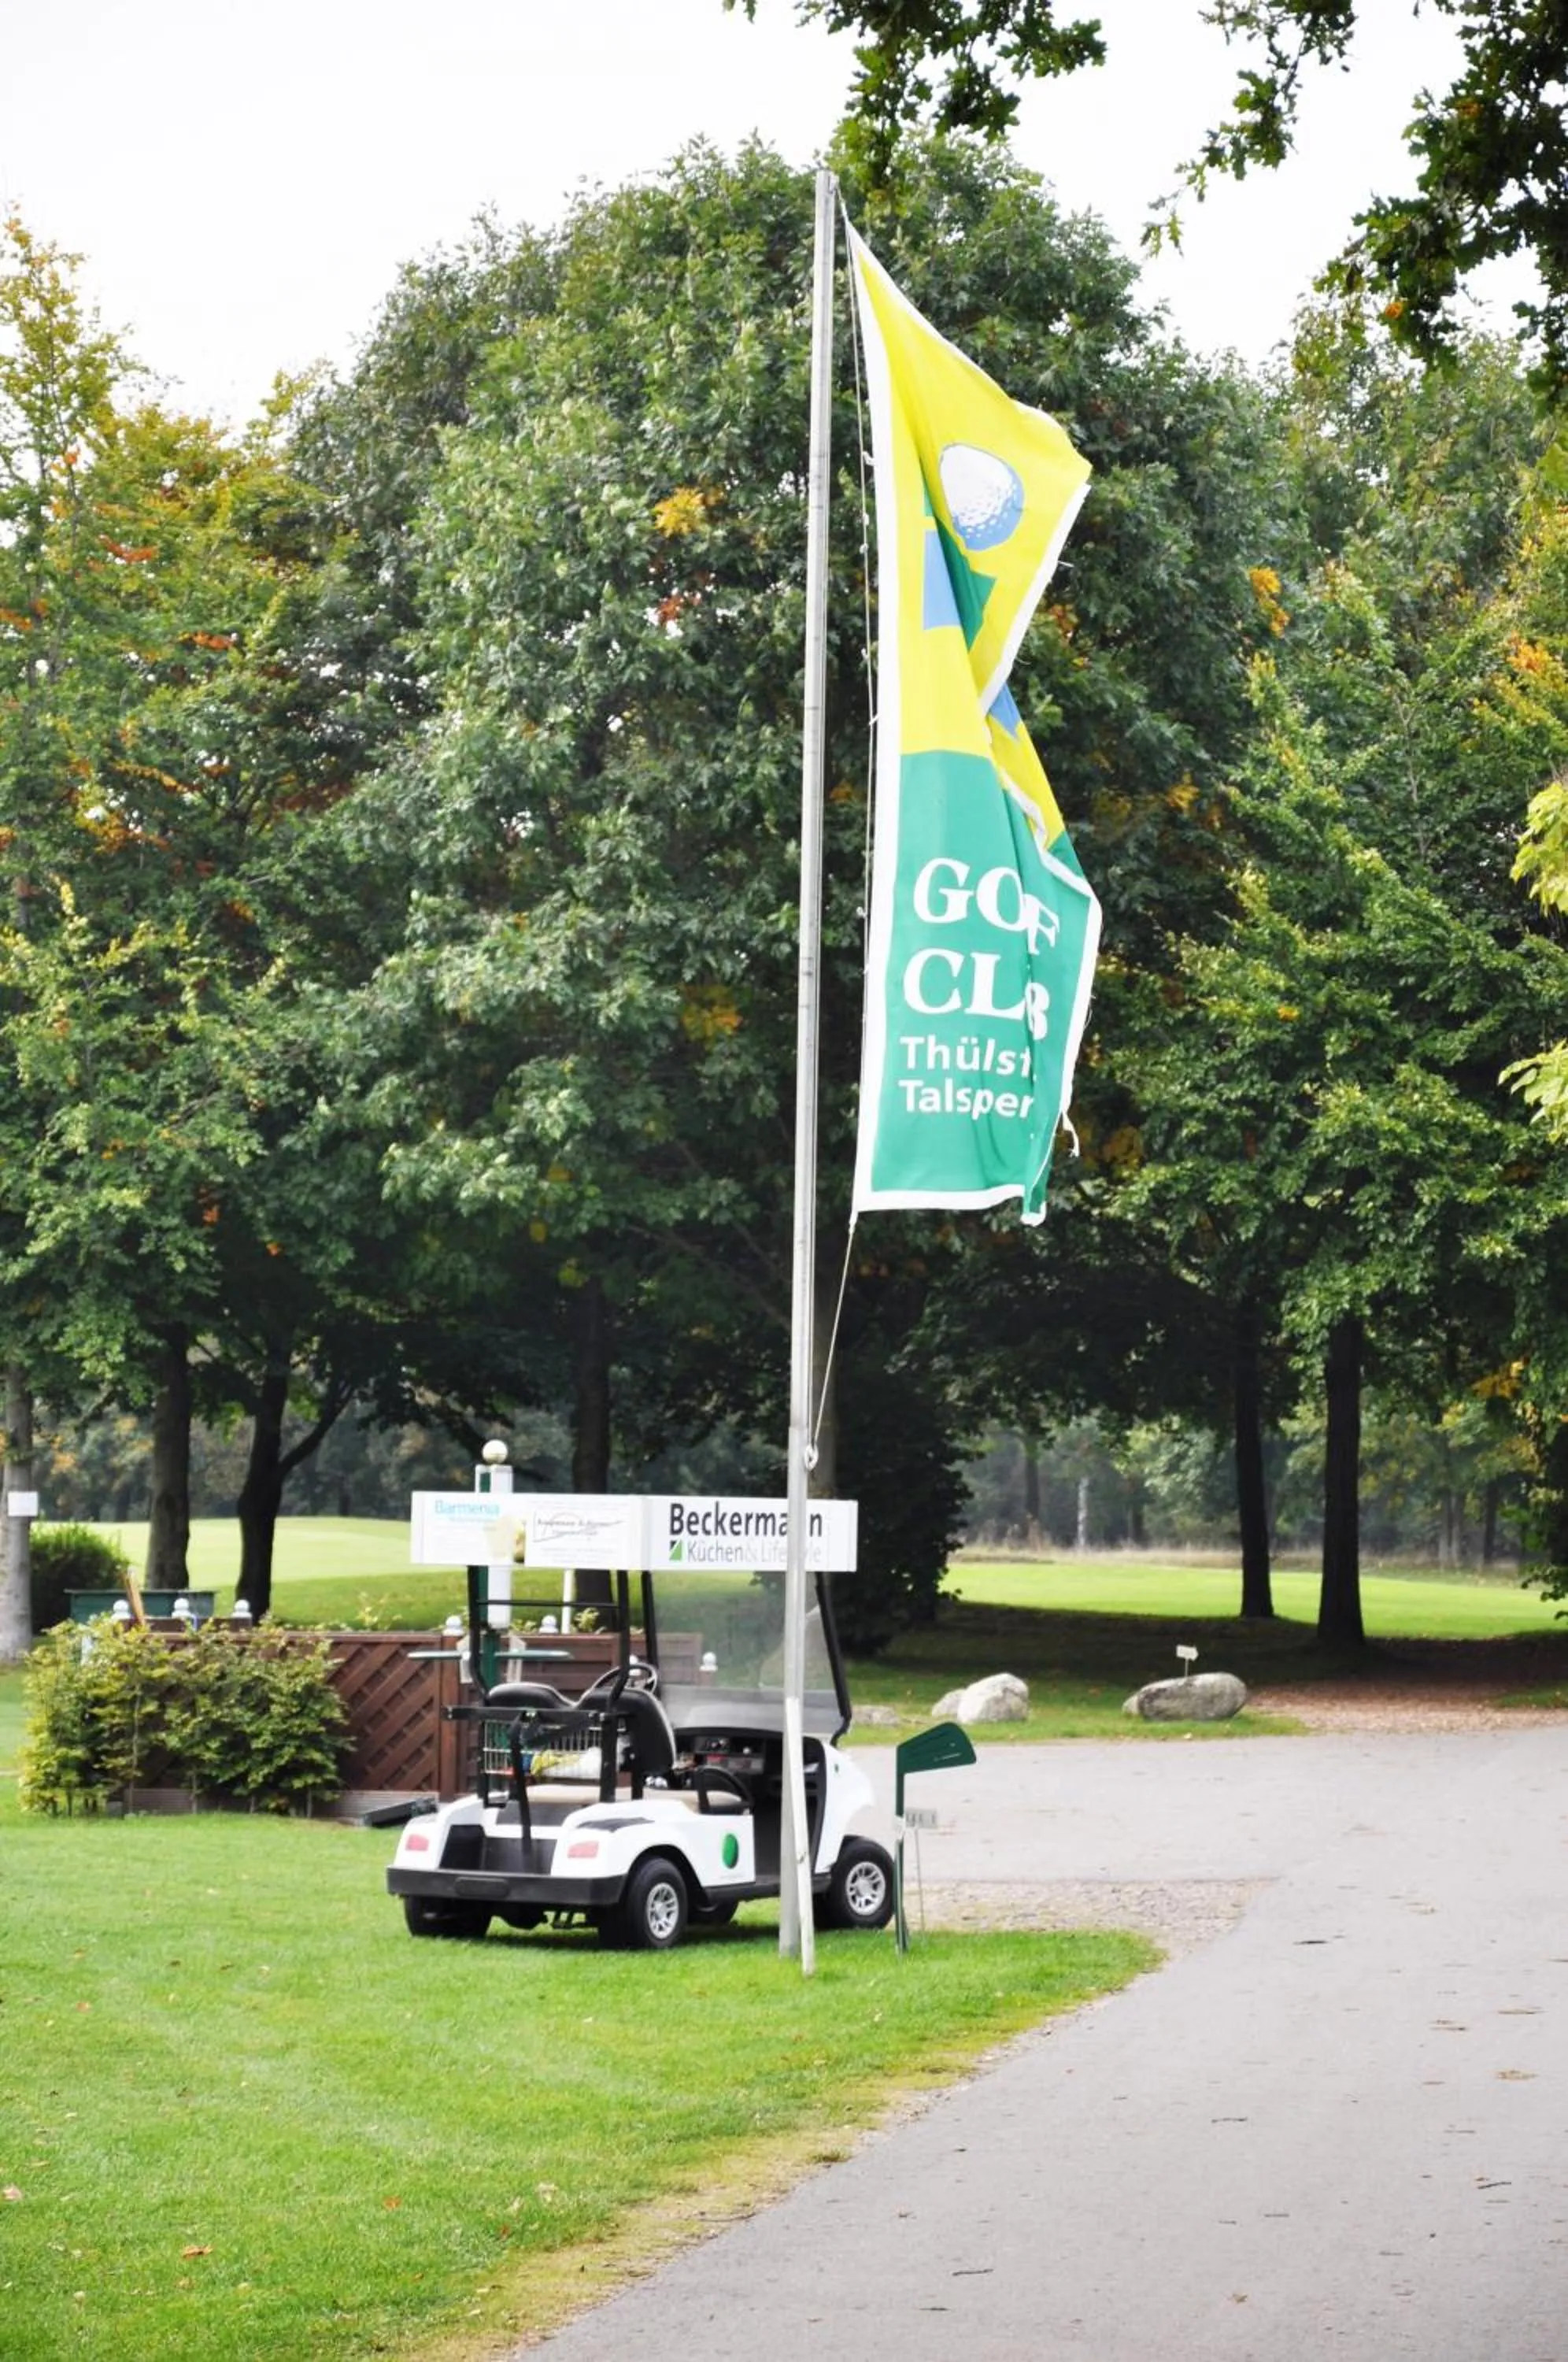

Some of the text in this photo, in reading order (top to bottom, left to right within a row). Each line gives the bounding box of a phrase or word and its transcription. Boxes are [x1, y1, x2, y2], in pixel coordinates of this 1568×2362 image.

[913, 857, 1060, 955] GOF
[903, 947, 1050, 1040] CLB
[669, 1500, 823, 1537] Beckerman
